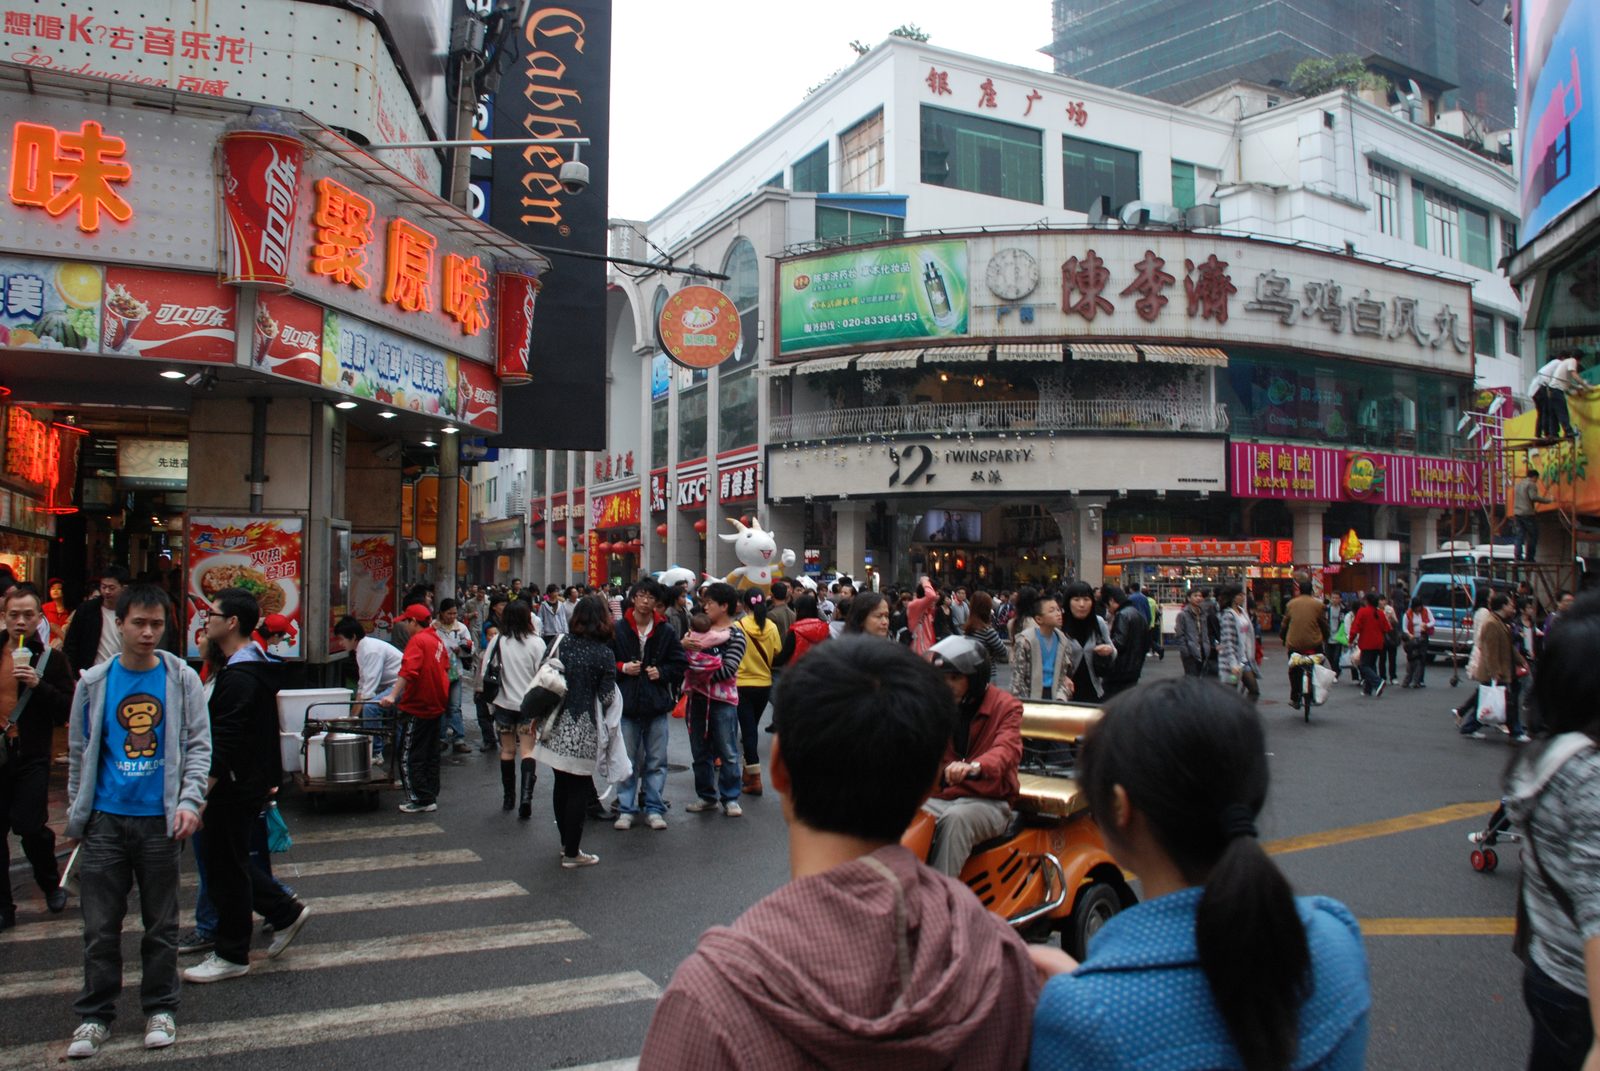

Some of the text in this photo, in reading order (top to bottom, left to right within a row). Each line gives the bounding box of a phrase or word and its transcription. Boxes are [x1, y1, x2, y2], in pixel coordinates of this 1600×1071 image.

[520, 7, 586, 225] Cabbeen
[926, 67, 1088, 127] 银座广场
[8, 119, 134, 233] 味
[311, 175, 490, 337] 聚原味
[0, 273, 44, 319] 美
[154, 303, 233, 328] 可口可乐
[1243, 268, 1469, 354] 乌鸡白凤丸
[280, 324, 321, 352] 可口可乐
[945, 448, 1033, 464] TWINSPARTY
[676, 477, 707, 506] KFC
[720, 466, 756, 499] 肯德基
